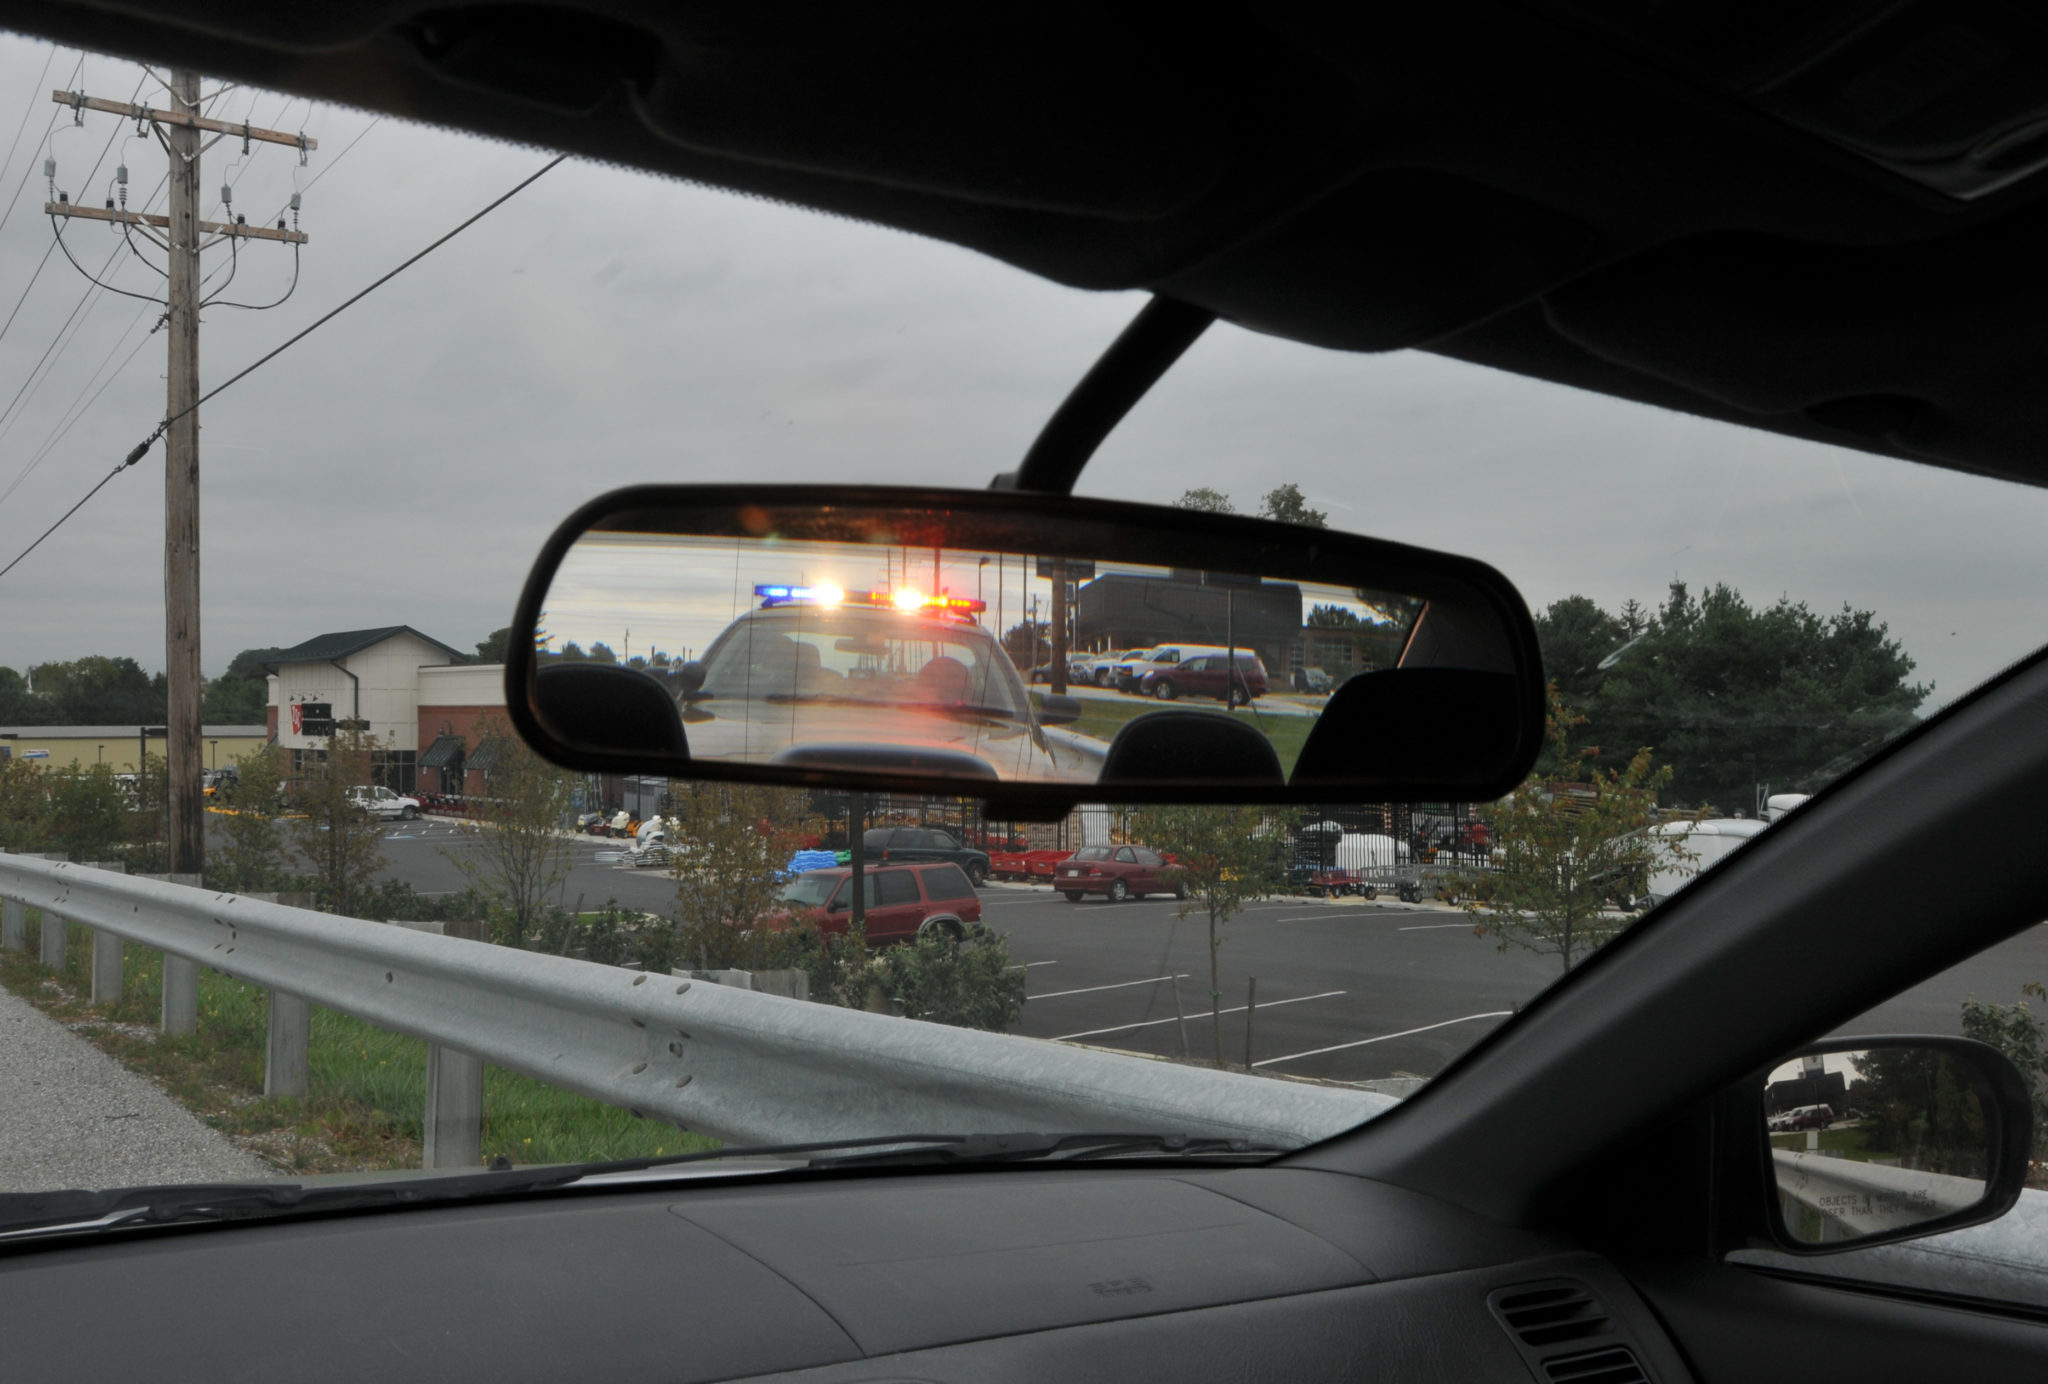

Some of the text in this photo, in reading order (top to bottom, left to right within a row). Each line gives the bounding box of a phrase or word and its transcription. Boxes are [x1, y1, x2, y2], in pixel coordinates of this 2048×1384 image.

[1819, 1195, 1857, 1206] OBJECTS
[1912, 1189, 1928, 1200] ARE
[1851, 1206, 1873, 1216] THAN
[1879, 1204, 1900, 1214] THEY
